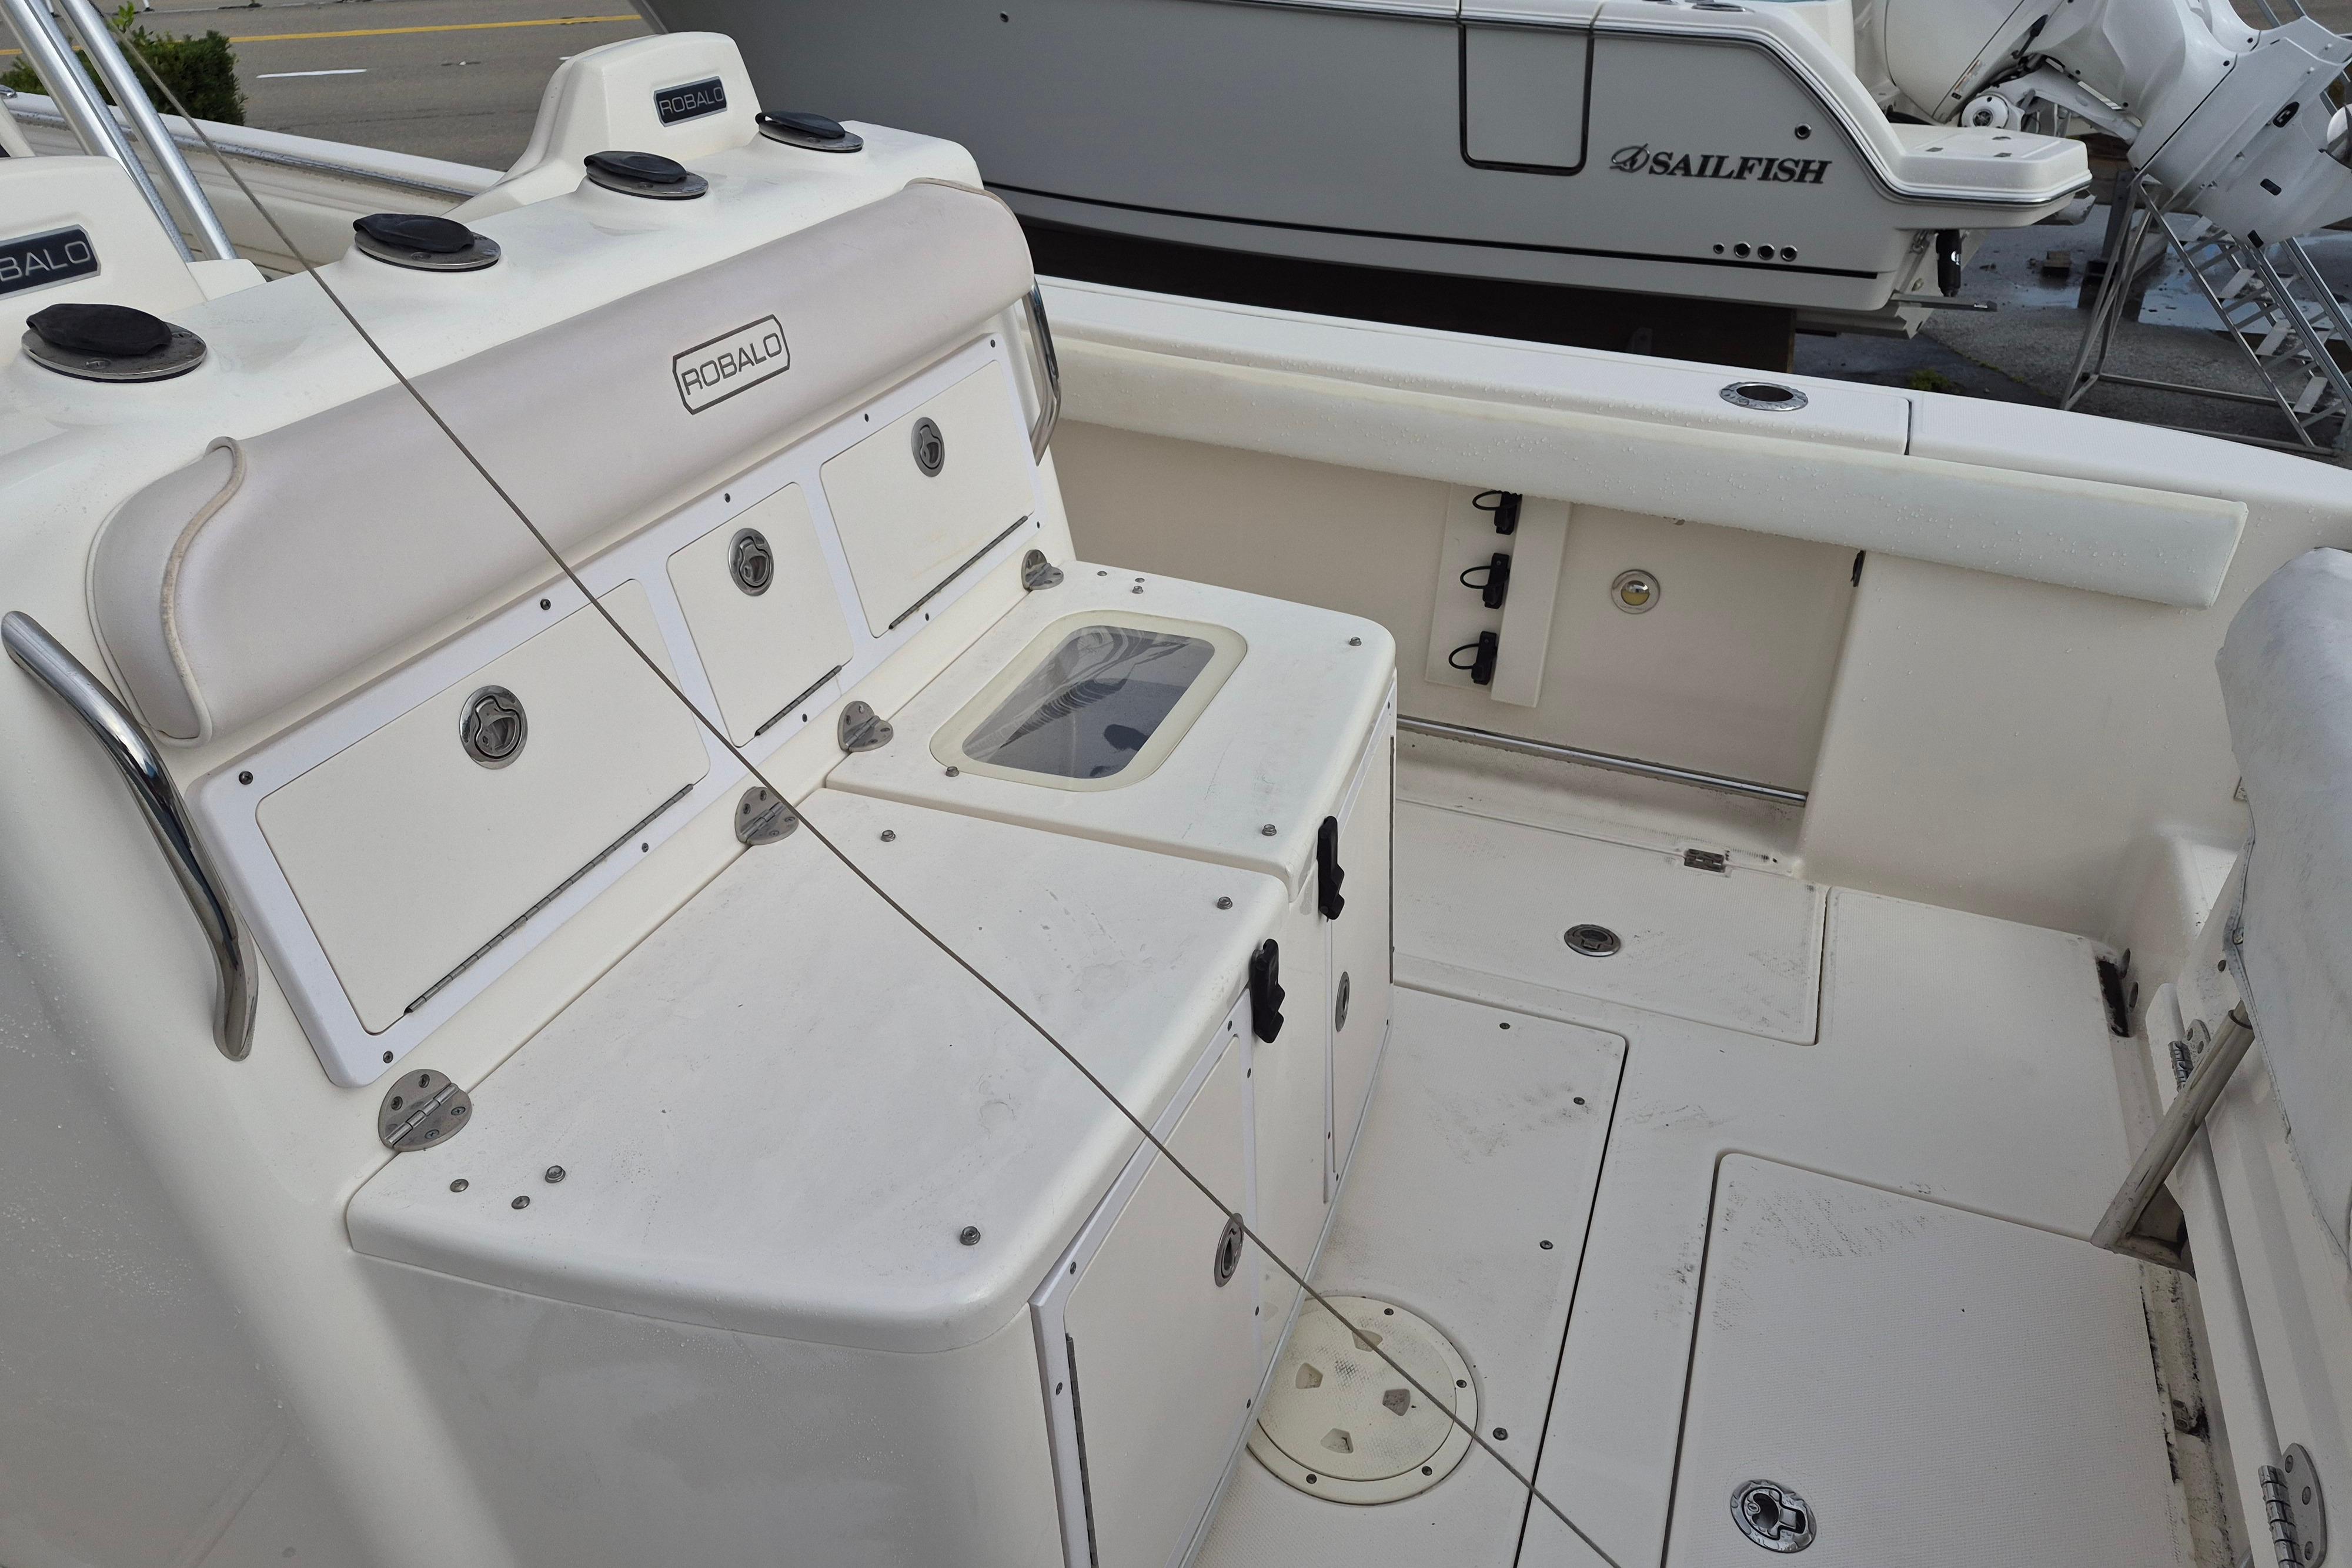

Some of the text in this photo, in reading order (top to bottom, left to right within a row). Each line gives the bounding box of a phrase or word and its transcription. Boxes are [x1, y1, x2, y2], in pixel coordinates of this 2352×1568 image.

[659, 86, 724, 116] ROBALO
[1648, 151, 1832, 184] SAILFISH
[0, 241, 90, 282] BALO
[681, 332, 782, 396] ROBALO
